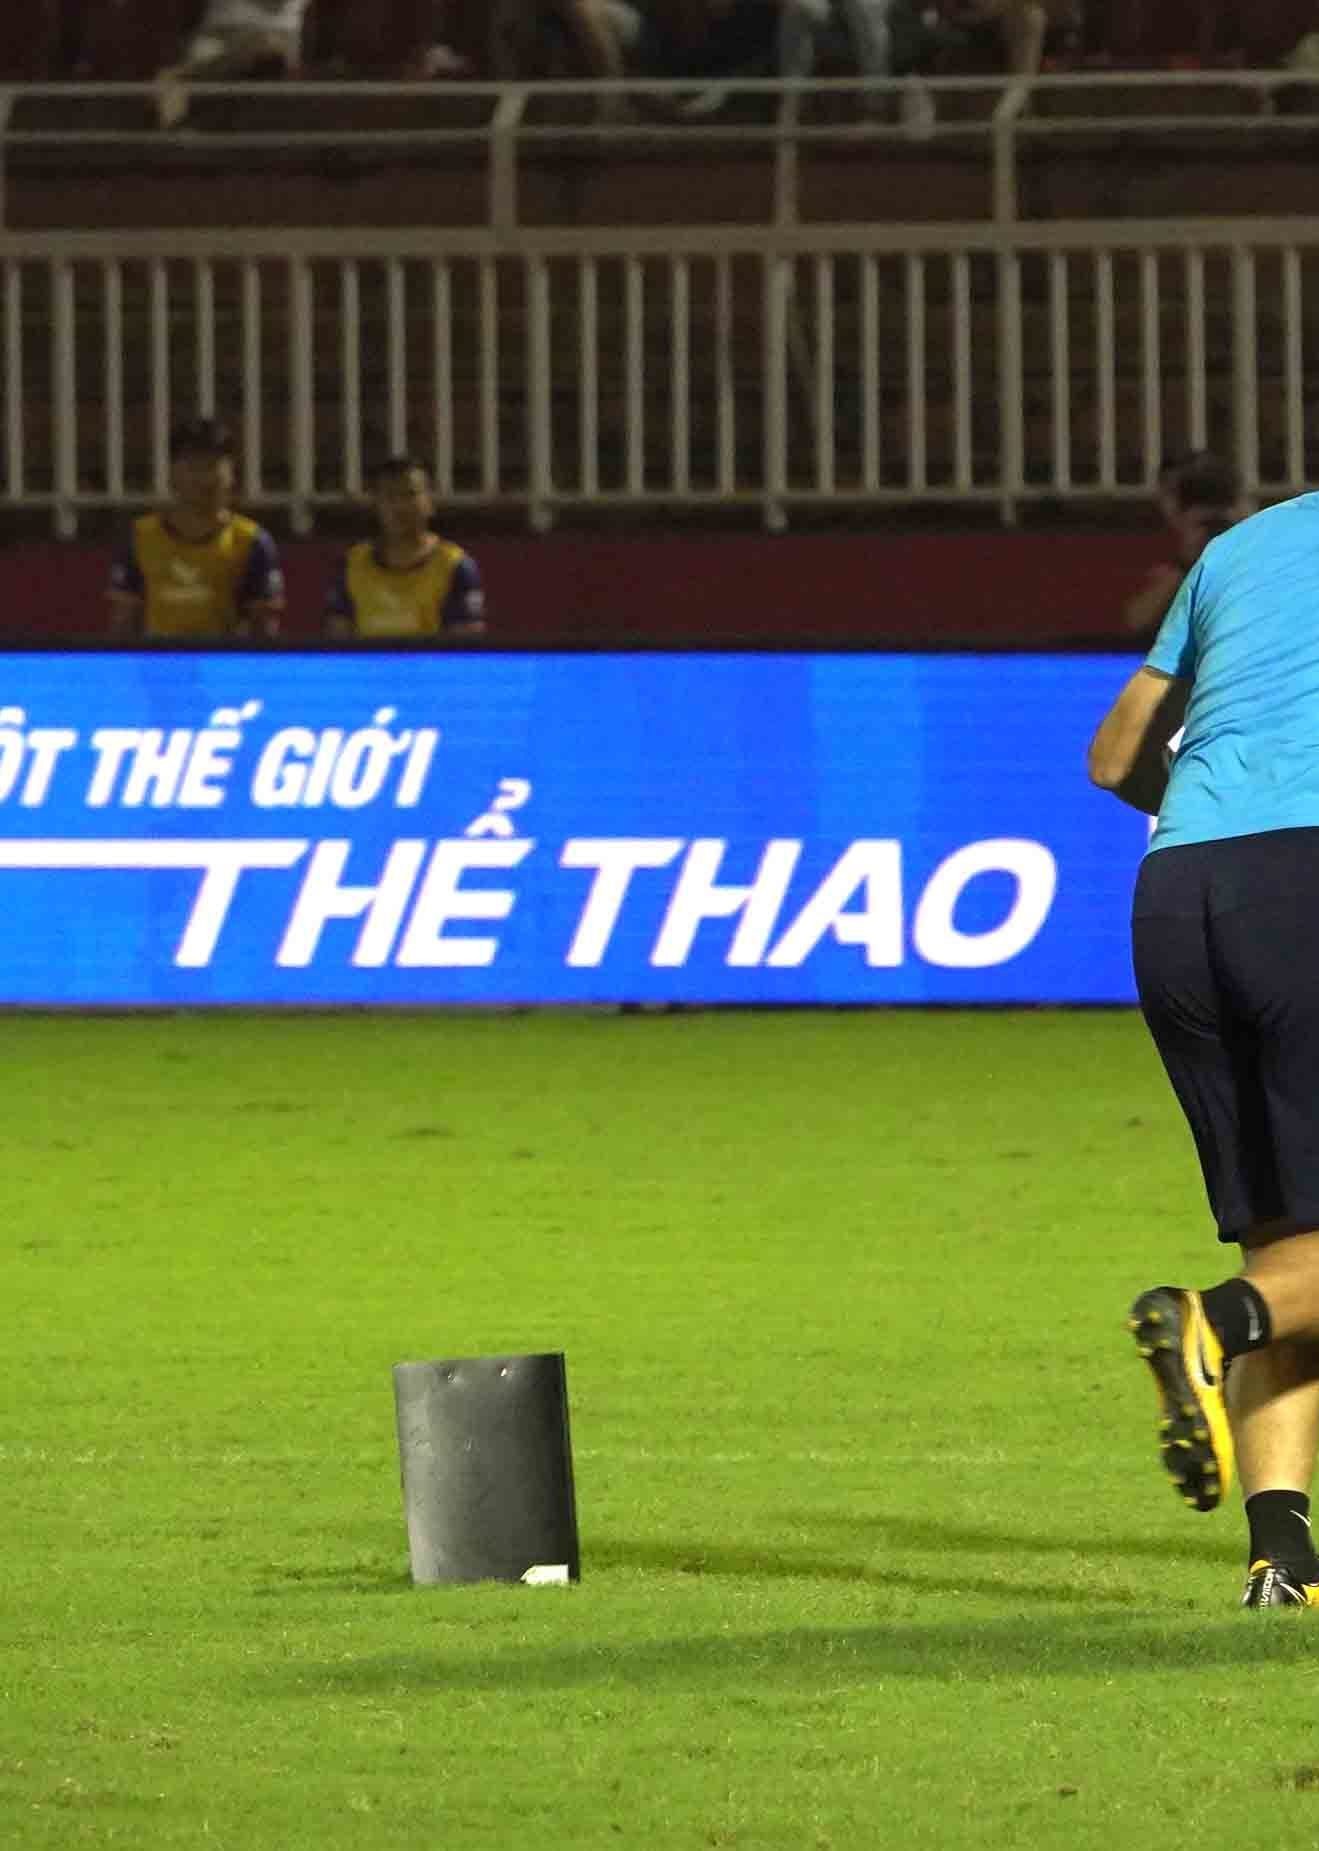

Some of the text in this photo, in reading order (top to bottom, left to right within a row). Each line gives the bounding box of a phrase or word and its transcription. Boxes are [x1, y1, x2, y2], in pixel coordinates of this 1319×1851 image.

[86, 700, 262, 808] THẾ
[250, 706, 439, 808] GIỚI
[172, 778, 1058, 968] THỂ THAO
